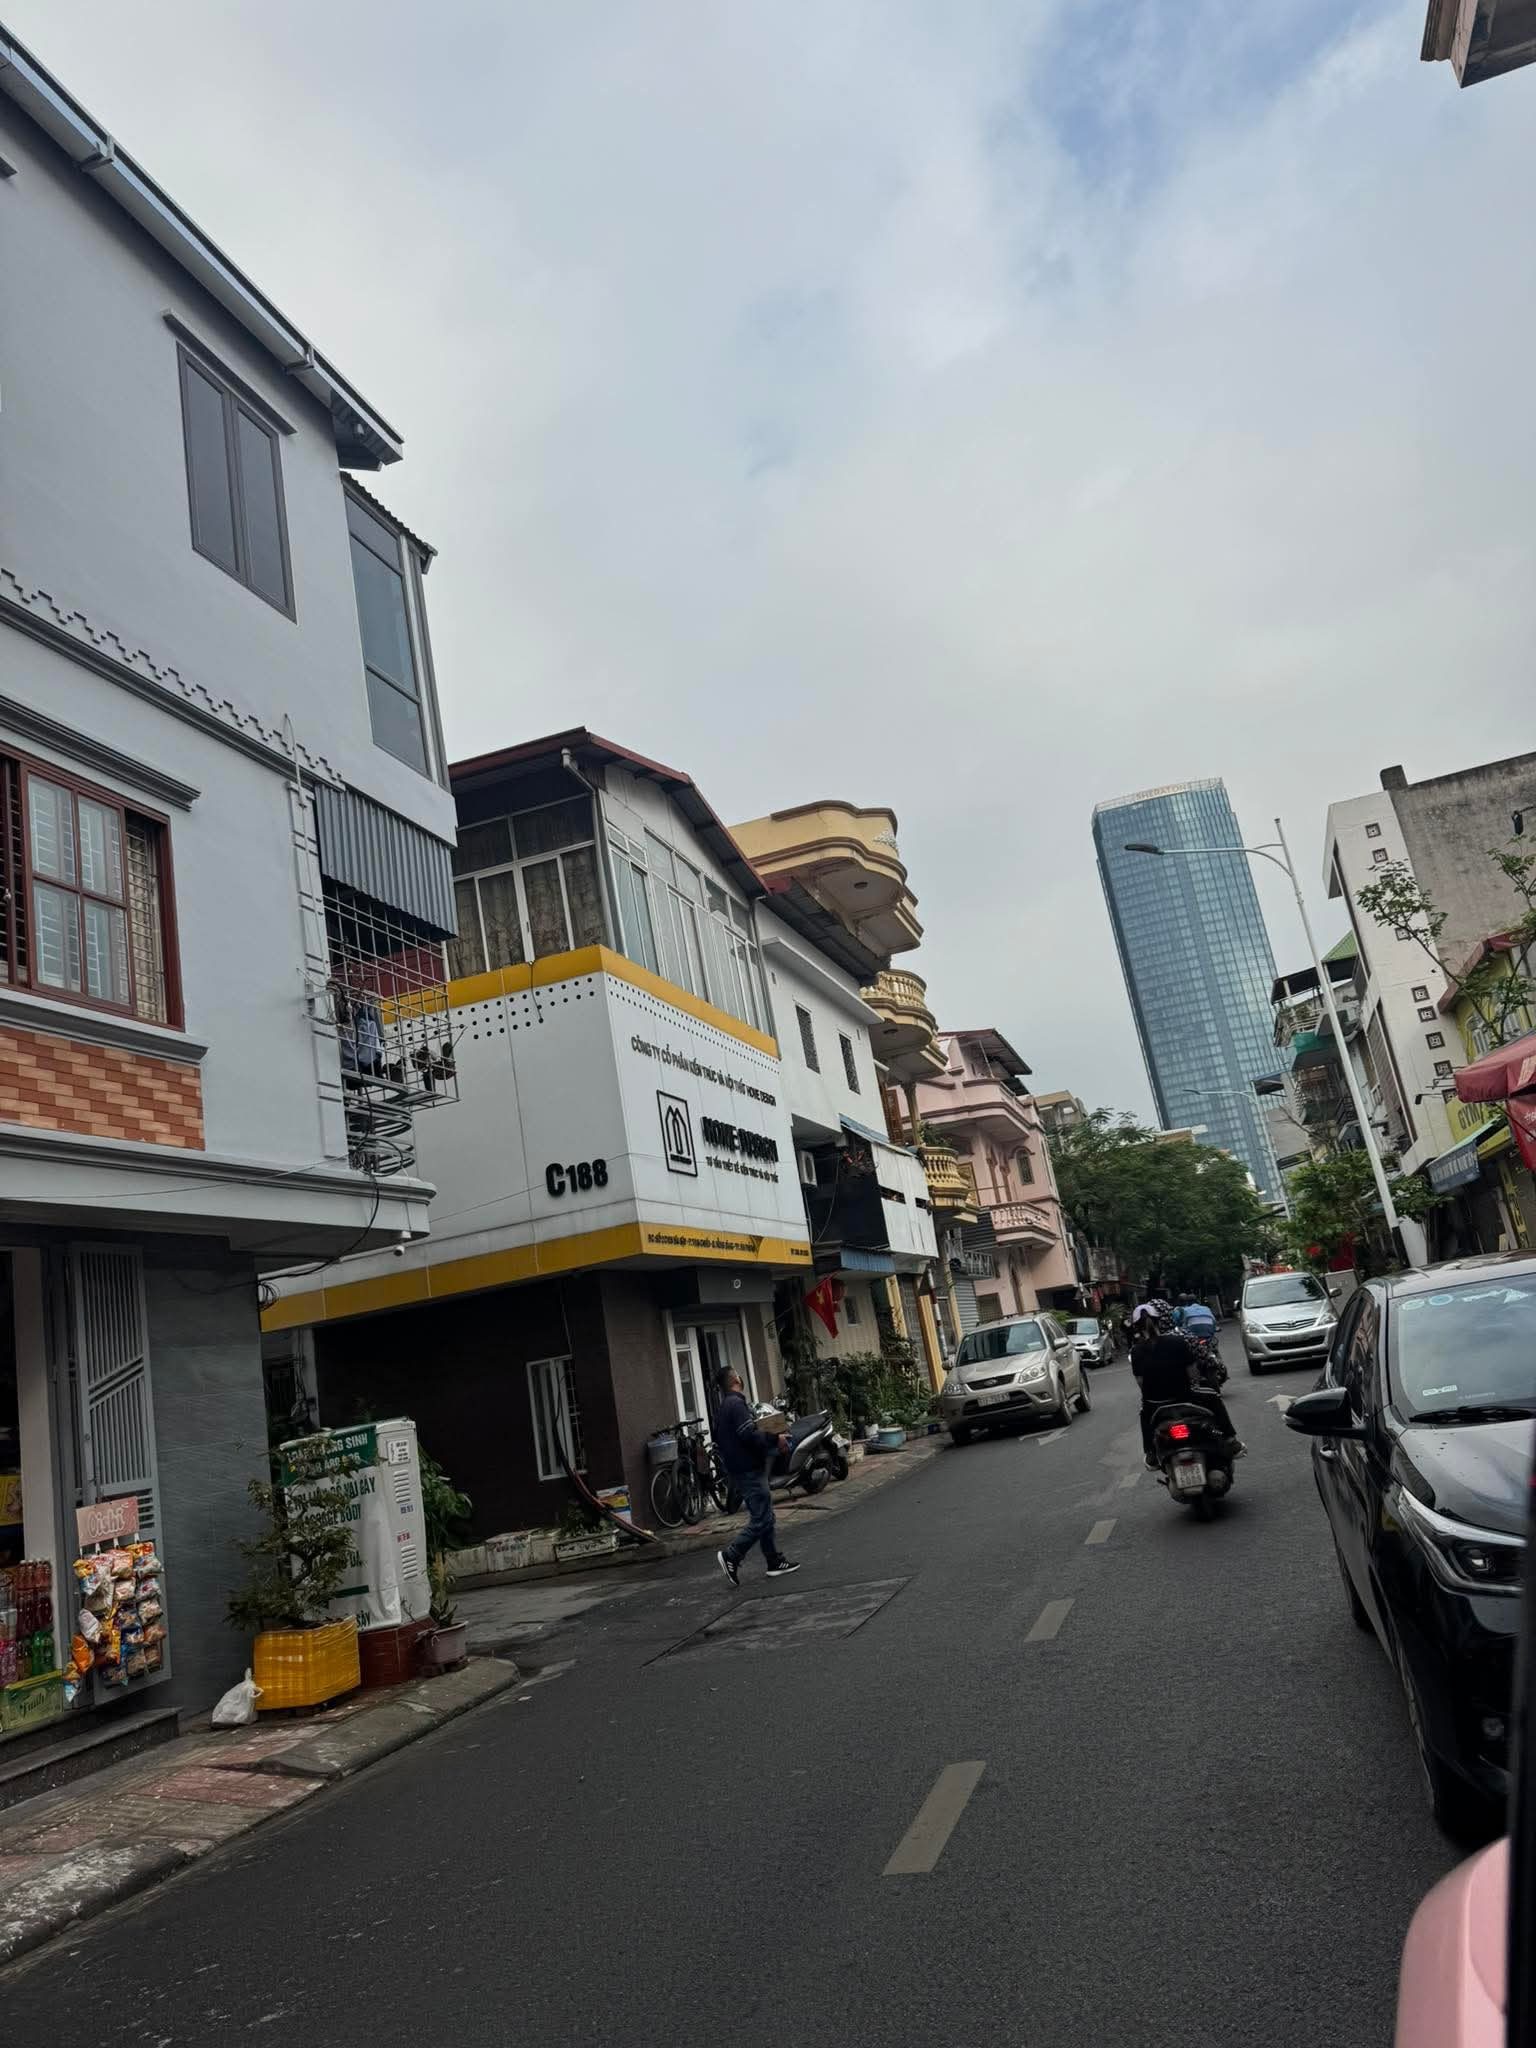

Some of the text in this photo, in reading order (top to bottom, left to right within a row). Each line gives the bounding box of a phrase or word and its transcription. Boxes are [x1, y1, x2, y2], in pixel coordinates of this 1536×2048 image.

[631, 1034, 652, 1057] CÔNG
[652, 1045, 660, 1061] TY
[661, 1043, 672, 1064] CỔ
[672, 1051, 689, 1072] PHẦN
[702, 1065, 717, 1083] TRÚC
[745, 1085, 760, 1101] HOME
[760, 1090, 777, 1107] DESIGN
[701, 1116, 779, 1163] HOME DESIGN
[545, 1158, 608, 1198] C188
[345, 1433, 368, 1449] SINH
[88, 1506, 126, 1538] Oishi
